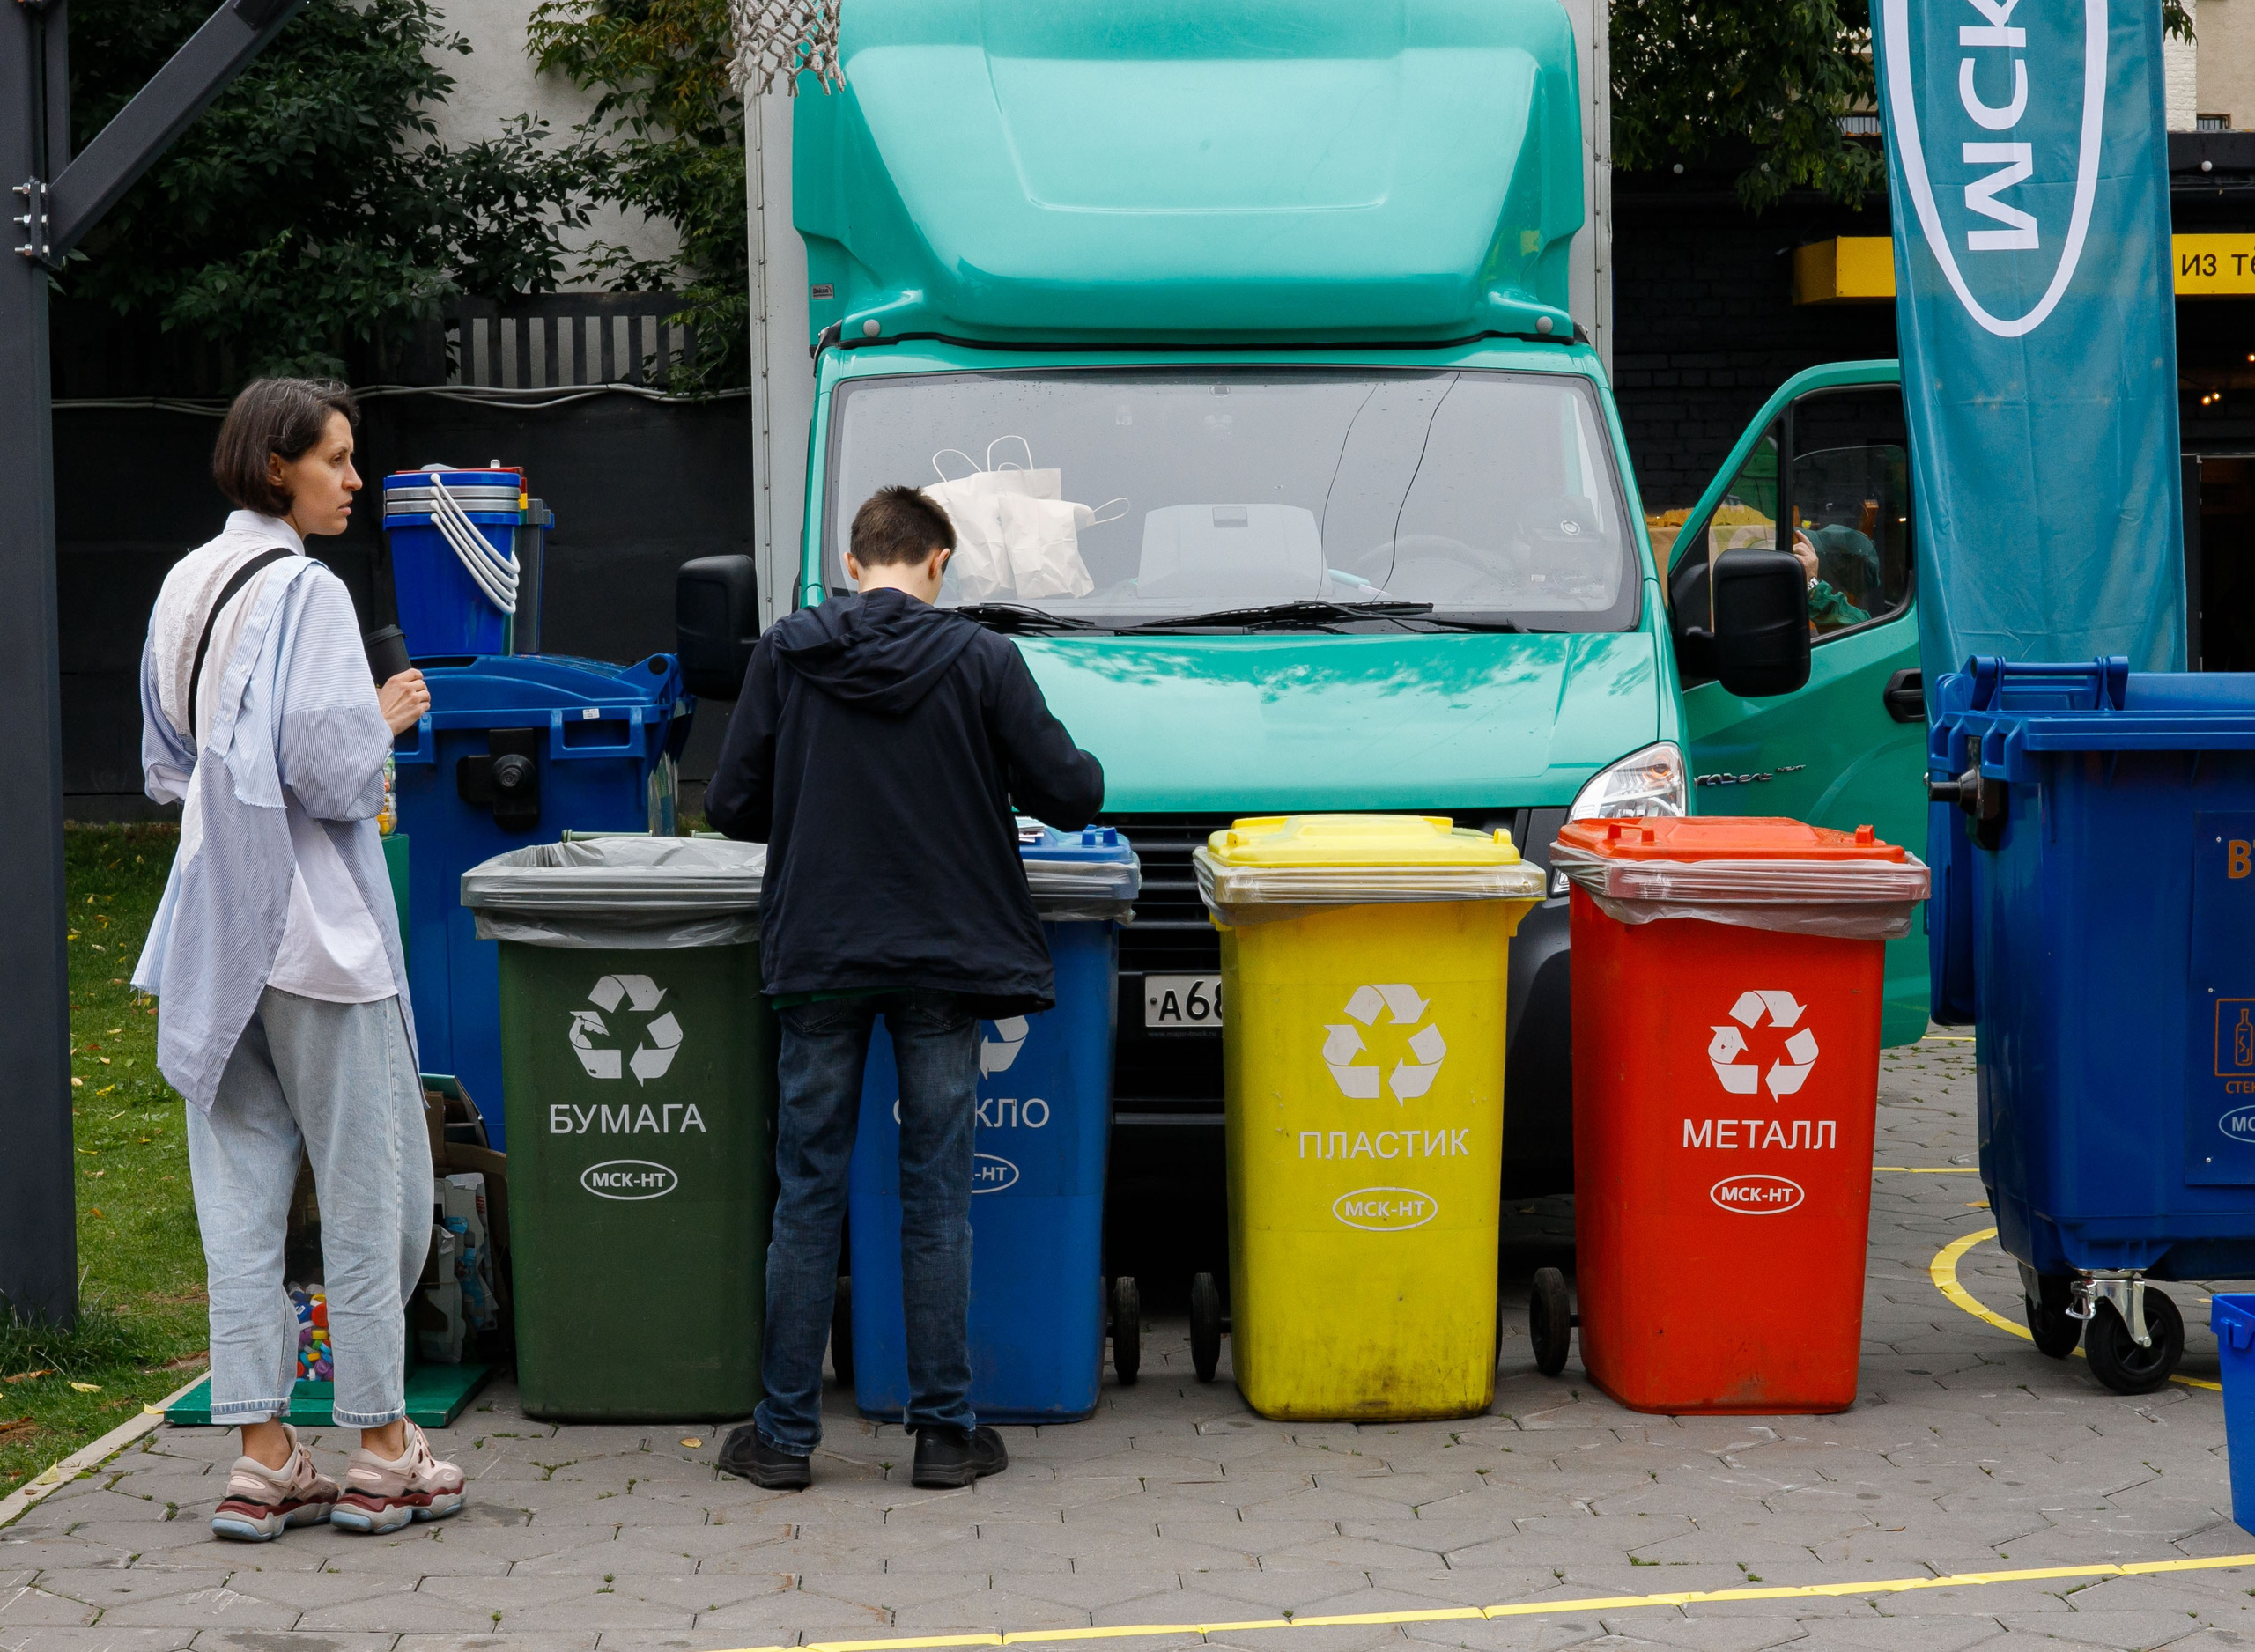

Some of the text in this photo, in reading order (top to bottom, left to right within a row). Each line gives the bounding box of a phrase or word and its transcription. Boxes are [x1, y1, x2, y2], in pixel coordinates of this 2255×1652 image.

[2228, 839, 2255, 879] В
[550, 1103, 707, 1134] БУМАГА
[1682, 1118, 1837, 1150] МЕТАЛЛ
[1299, 1128, 1469, 1160] ПЛАСТИК
[592, 1173, 666, 1187] МСК-НТ
[1721, 1187, 1793, 1202] МСК-НТ
[1345, 1201, 1425, 1217] МСК-НТ
